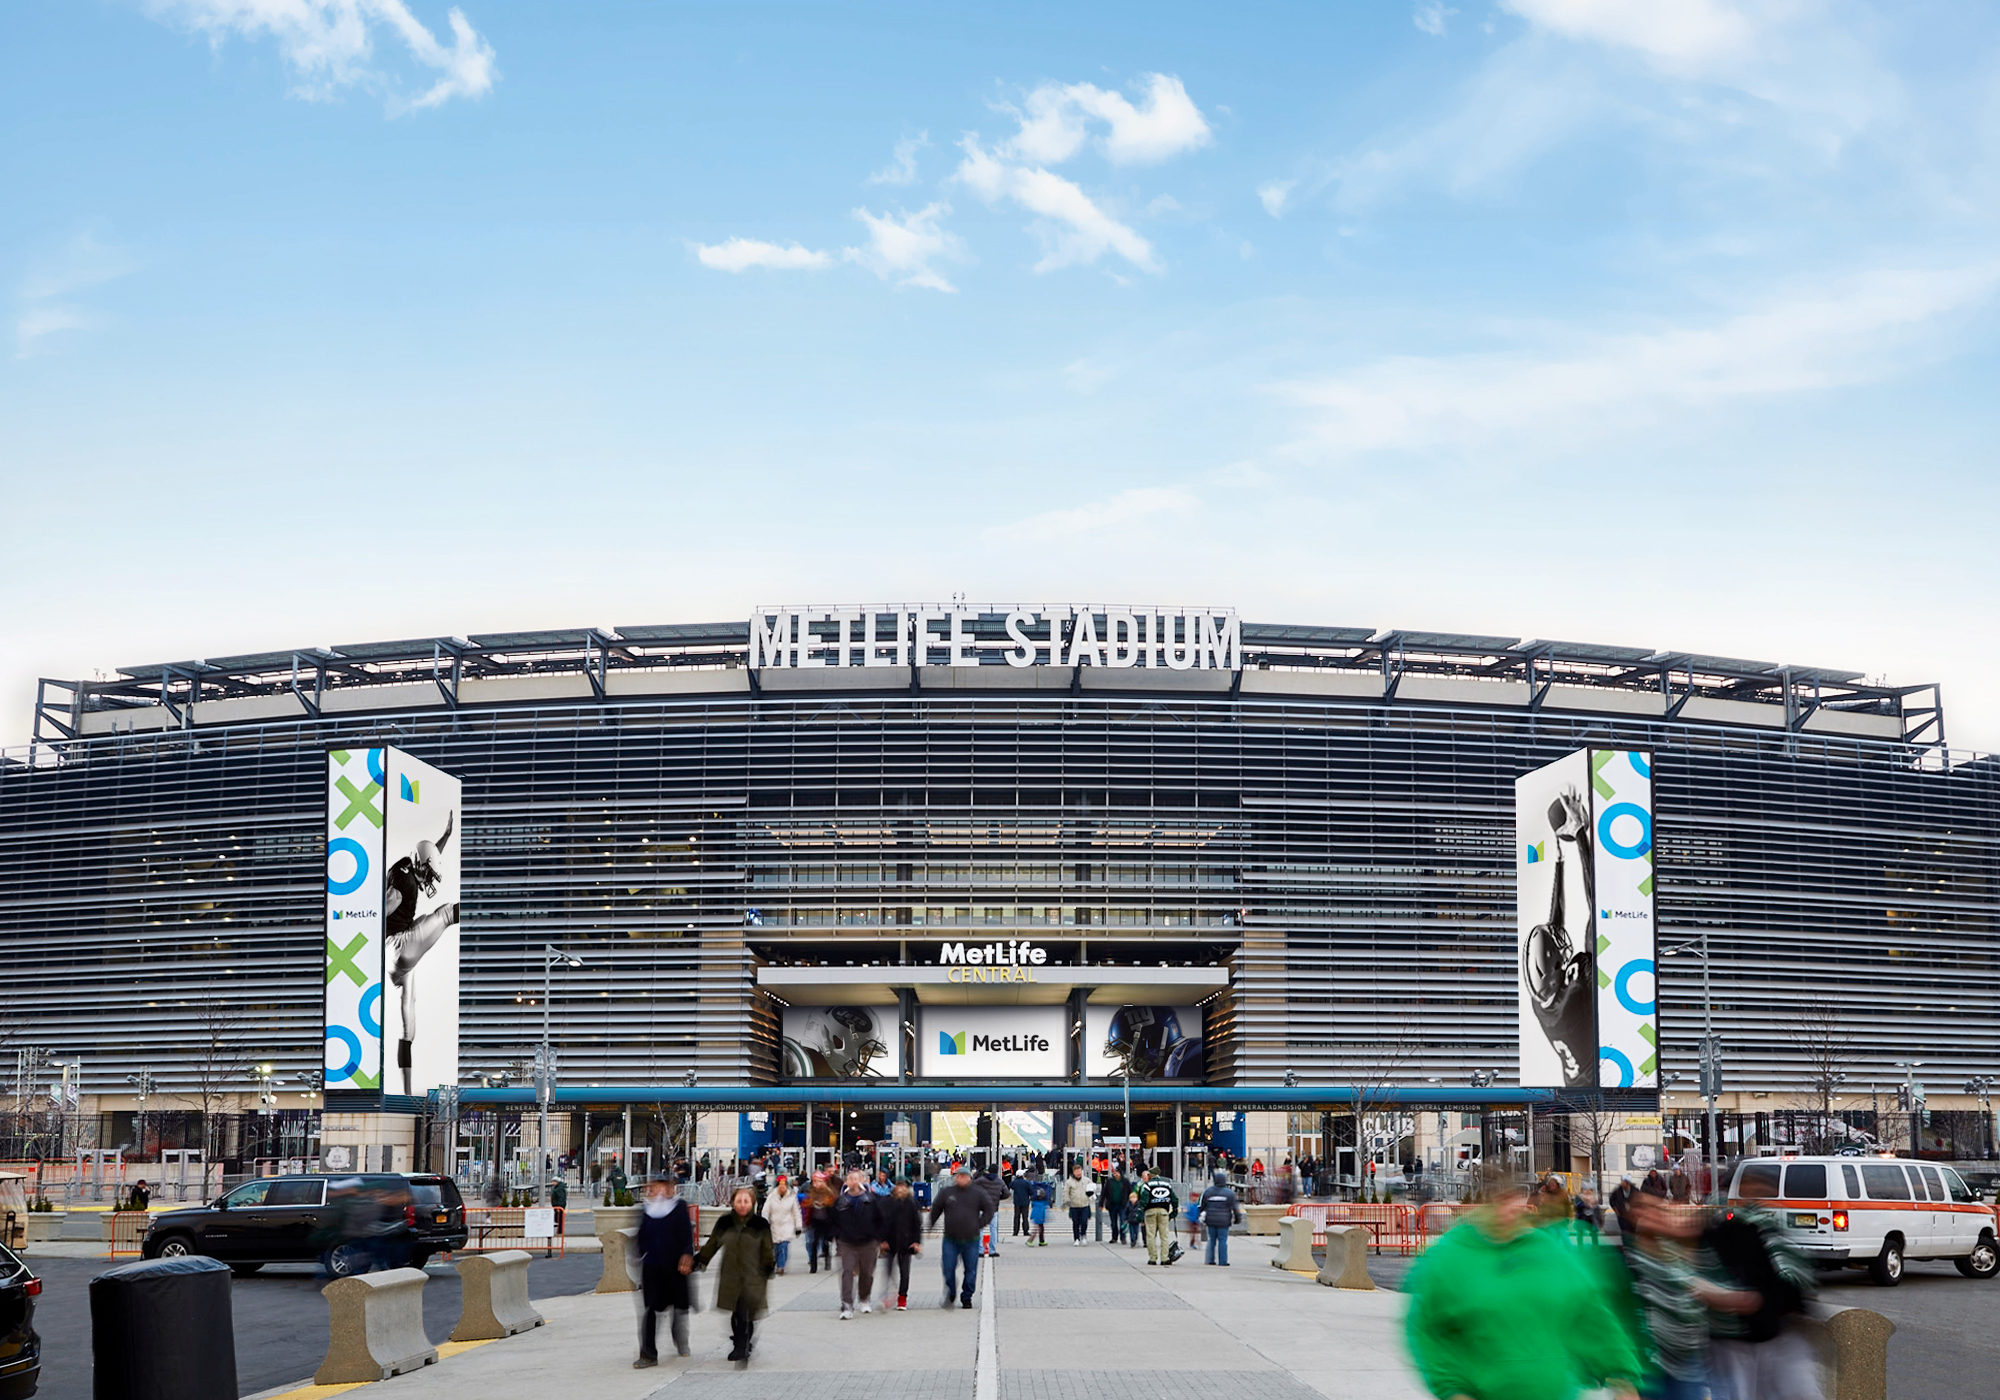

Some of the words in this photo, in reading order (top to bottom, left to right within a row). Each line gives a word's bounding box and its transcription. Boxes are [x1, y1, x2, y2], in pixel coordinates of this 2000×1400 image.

[749, 611, 980, 669] METLIFE
[1004, 611, 1241, 670] STADIUM
[346, 910, 377, 918] MetLife
[1615, 910, 1647, 919] MetLife
[940, 940, 1047, 964] MetLife
[947, 966, 1037, 983] CENTRAL
[972, 1034, 1049, 1052] MetLife
